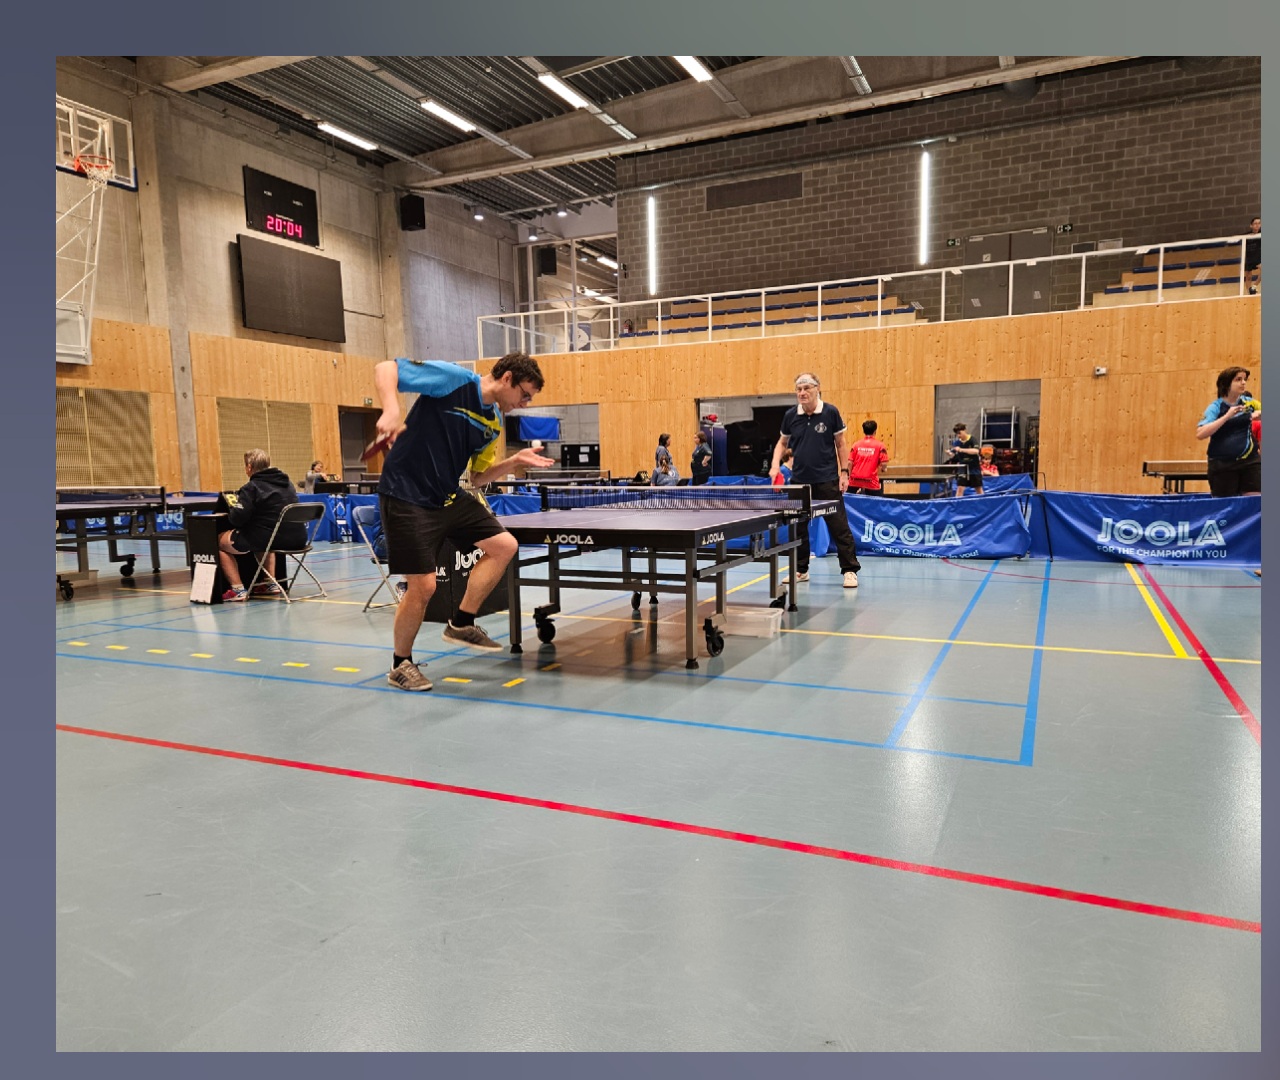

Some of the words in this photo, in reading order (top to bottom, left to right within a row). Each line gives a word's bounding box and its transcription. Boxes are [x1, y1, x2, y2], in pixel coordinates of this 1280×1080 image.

[266, 214, 302, 239] 20:04
[553, 534, 594, 545] JOOLA
[861, 520, 962, 546] JOOLA
[1097, 517, 1226, 546] JOOLA
[192, 553, 216, 564] JOOLA
[1117, 546, 1134, 555] THE
[1136, 549, 1189, 558] CHAMPION
[1192, 550, 1203, 558] IN
[1205, 550, 1227, 558] YOU
